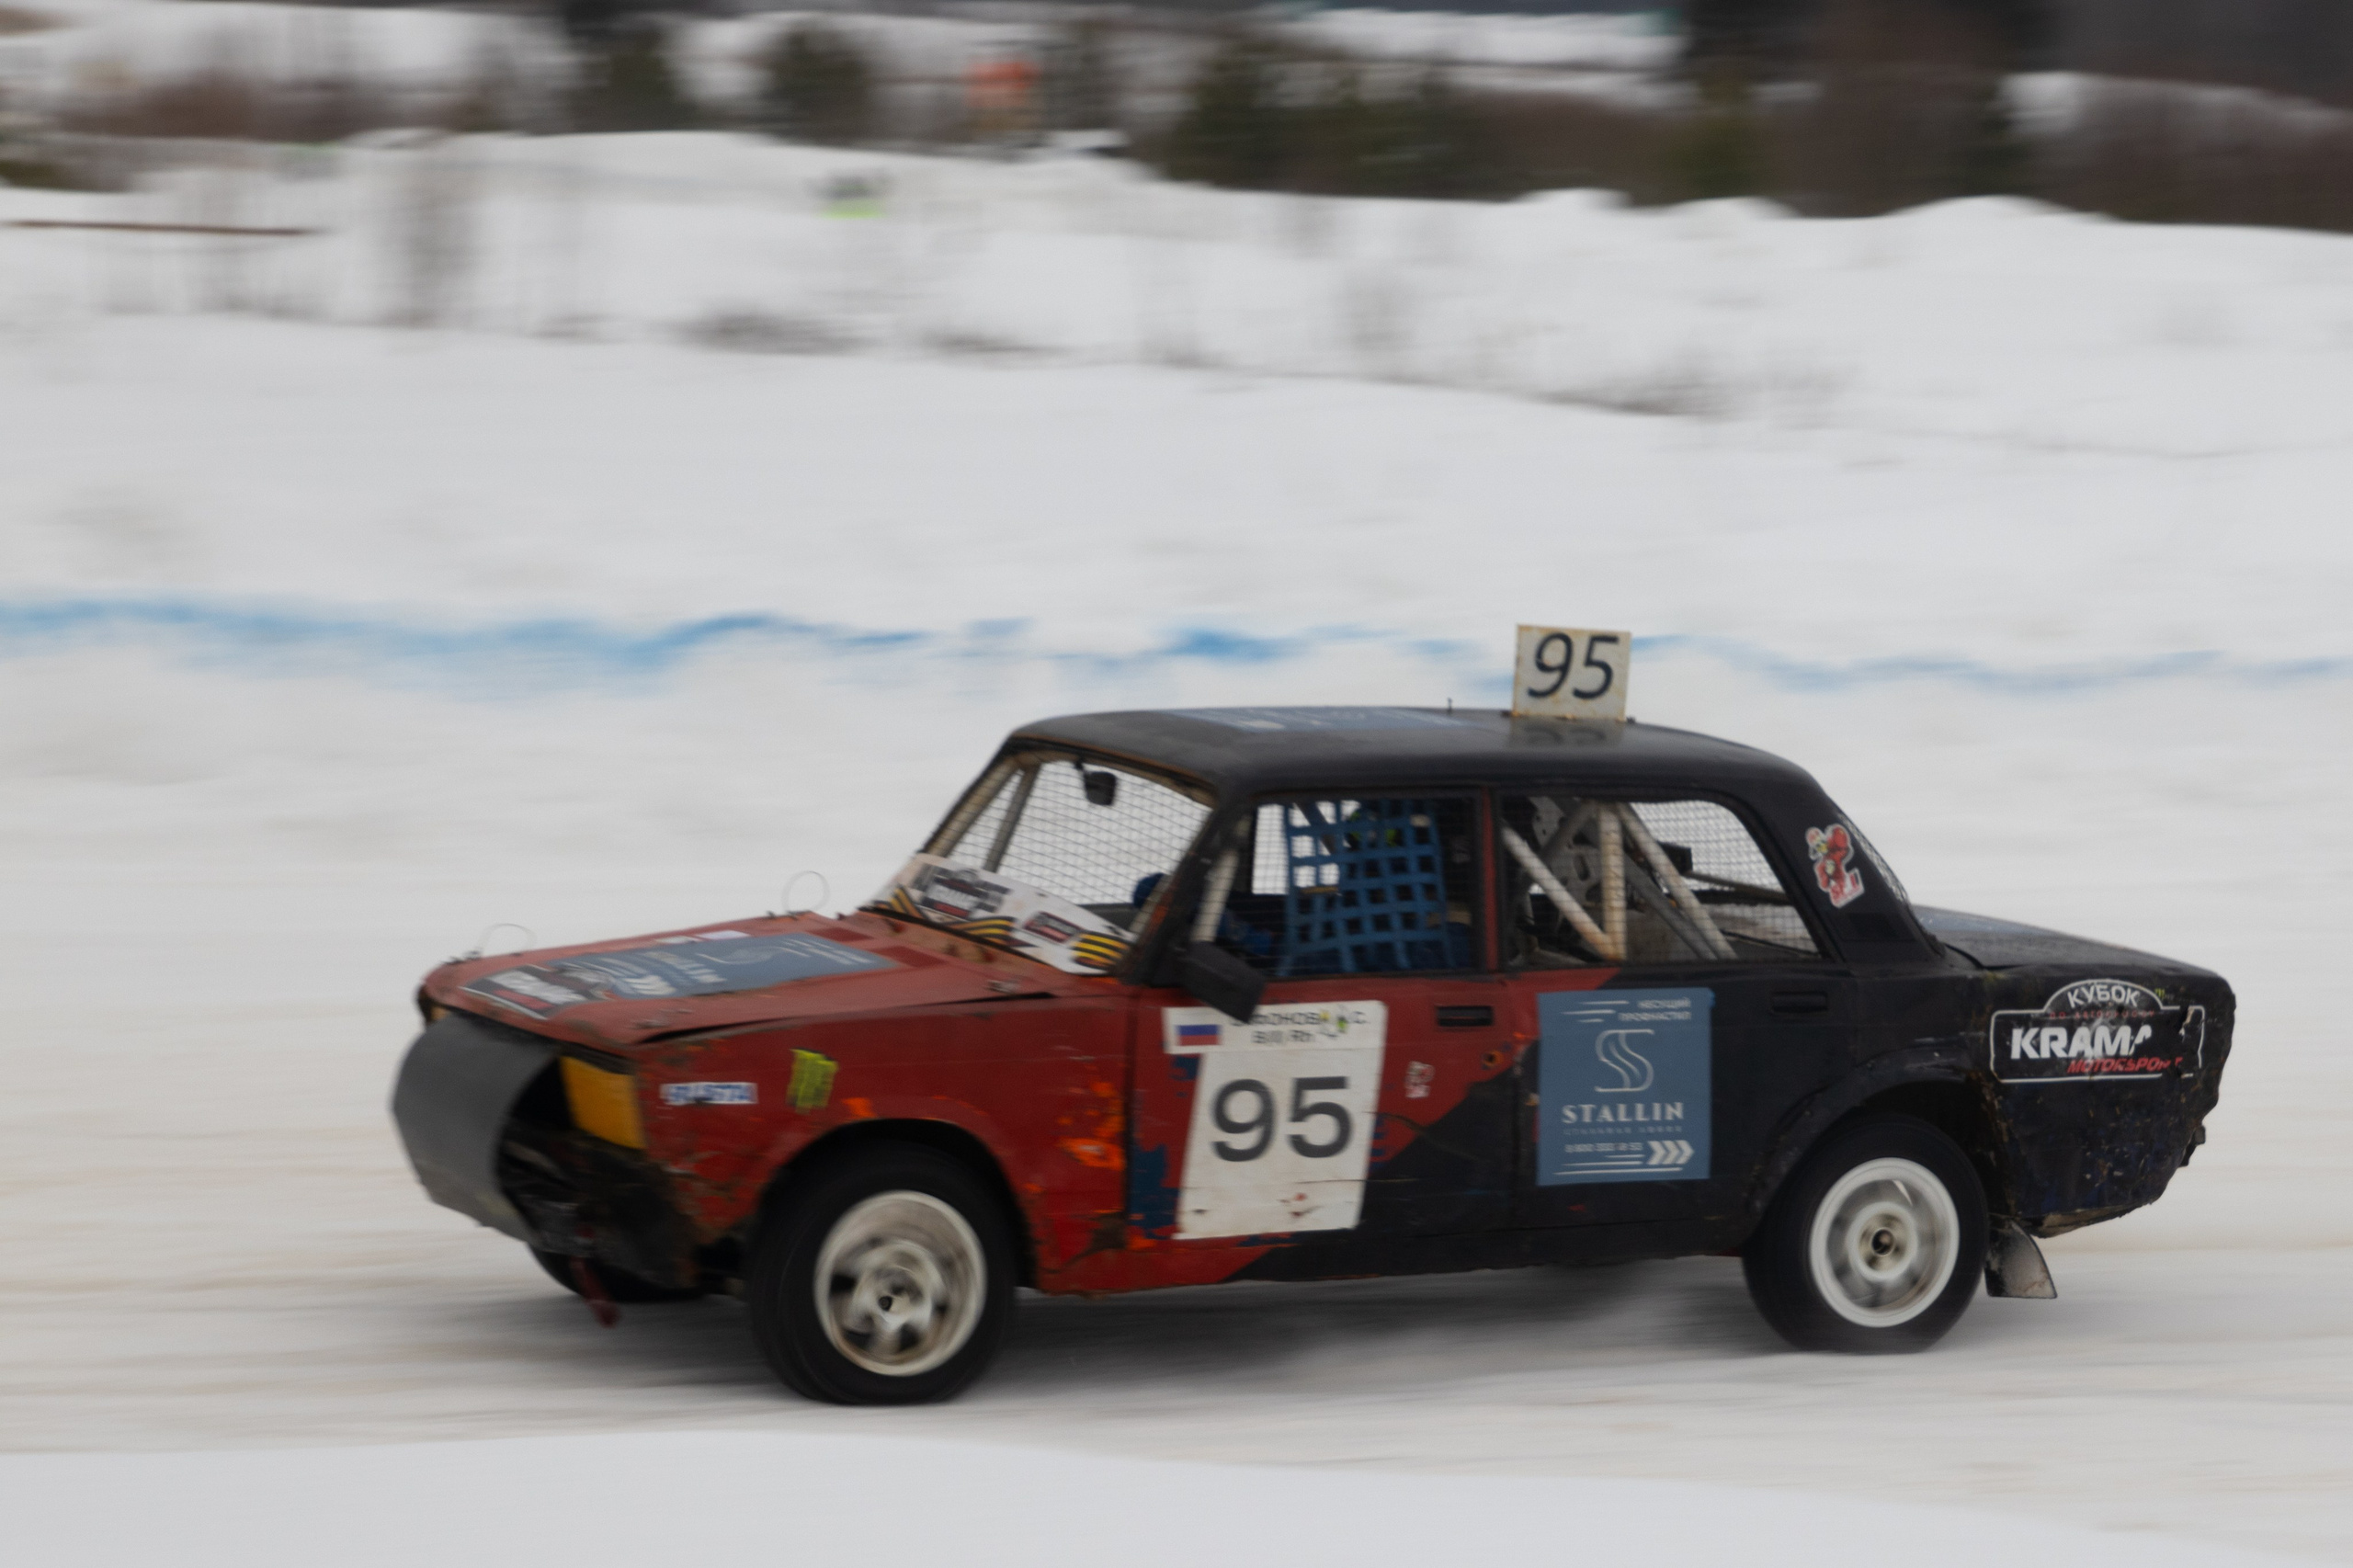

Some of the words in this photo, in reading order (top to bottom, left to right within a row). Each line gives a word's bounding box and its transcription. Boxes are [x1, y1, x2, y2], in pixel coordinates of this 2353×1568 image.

[1528, 632, 1619, 699] 95
[2067, 984, 2141, 1009] КУБОК
[1211, 1076, 1352, 1163] 95
[1562, 1102, 1684, 1124] STALLIN
